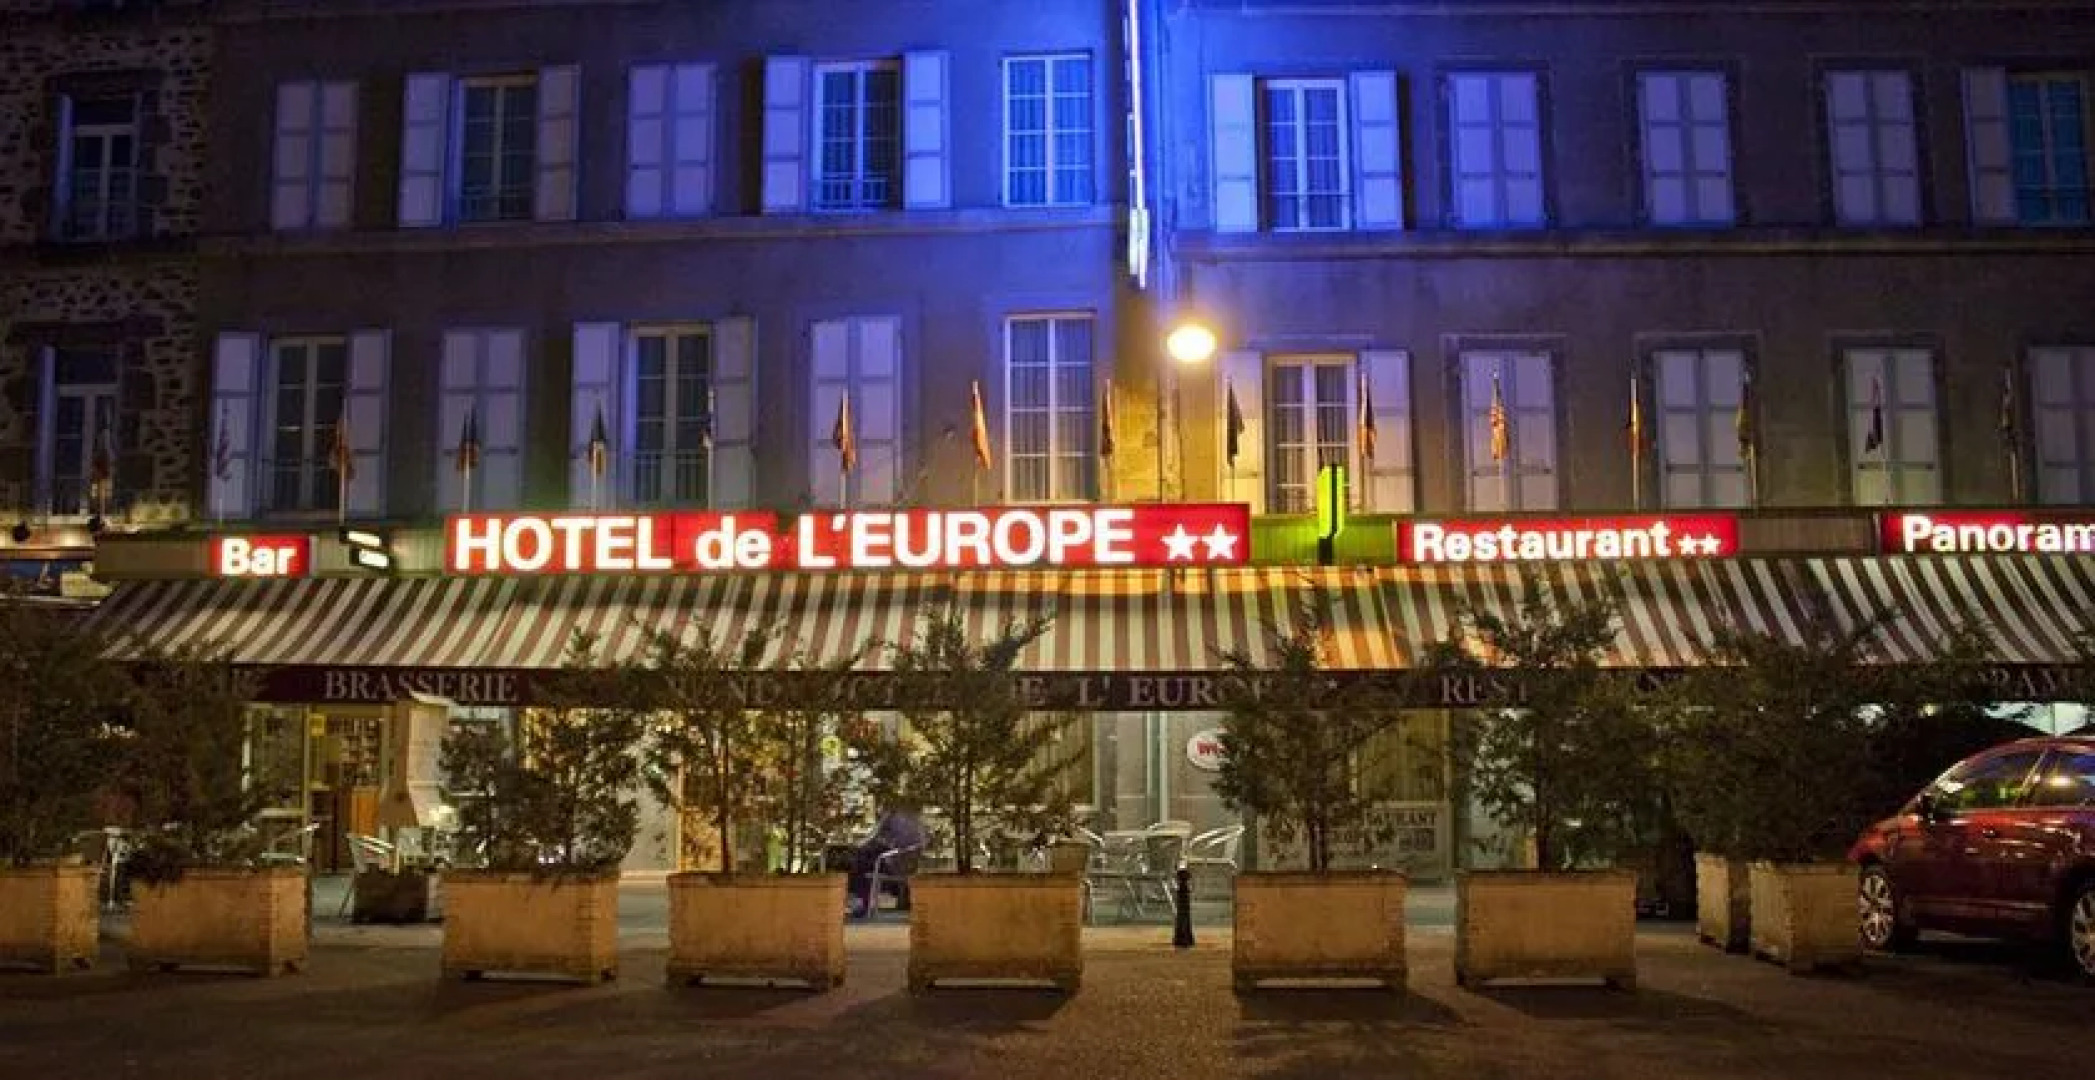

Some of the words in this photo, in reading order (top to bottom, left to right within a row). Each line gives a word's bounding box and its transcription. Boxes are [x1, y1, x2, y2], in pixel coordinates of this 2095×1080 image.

[221, 537, 298, 575] Bar
[455, 516, 673, 571] HOTEL
[695, 516, 773, 568] de
[799, 508, 1134, 567] L'EUROPE
[1412, 519, 1671, 562] Restaurant
[324, 669, 517, 701] BRASSERIE
